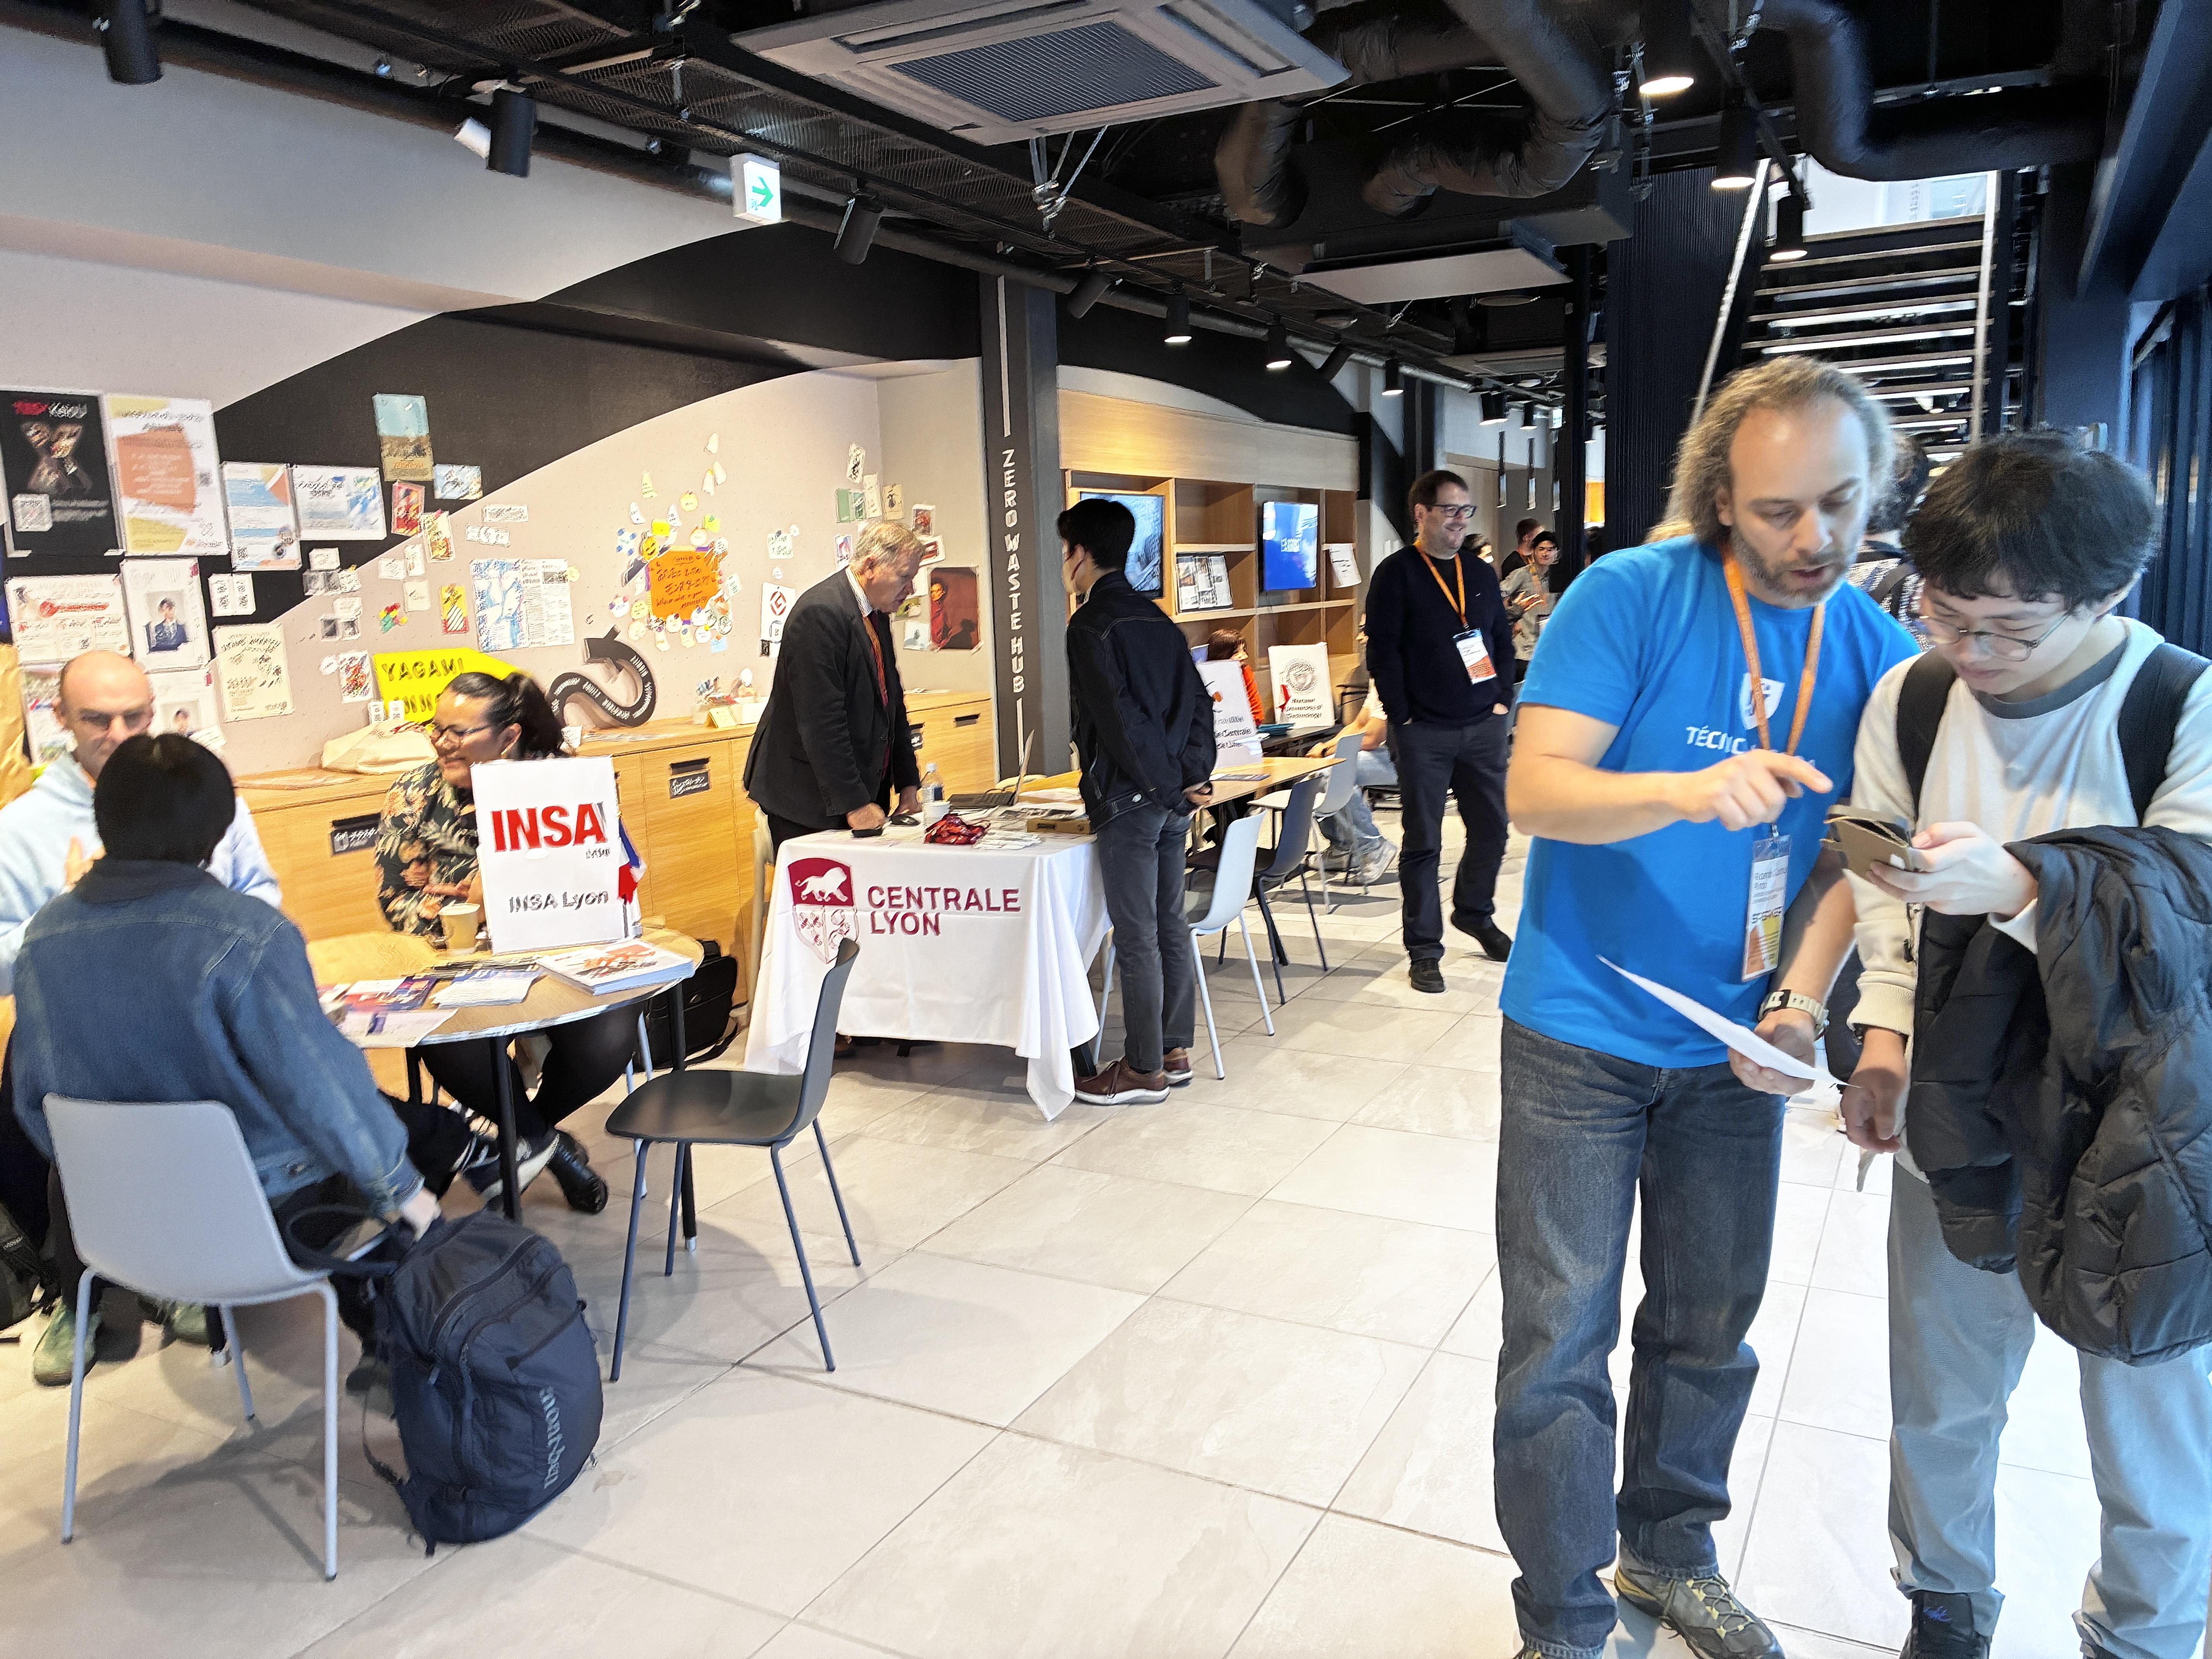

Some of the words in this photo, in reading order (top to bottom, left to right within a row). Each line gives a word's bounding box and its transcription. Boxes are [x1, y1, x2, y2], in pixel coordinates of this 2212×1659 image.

[1002, 449, 1018, 527] ZERO
[1005, 533, 1023, 630] WASTE
[381, 657, 464, 682] YAGAMI
[1011, 636, 1025, 693] HUB
[491, 802, 608, 852] INSA
[509, 893, 558, 913] INSA
[562, 891, 609, 910] Lyon
[867, 885, 1021, 912] CENTRALE
[870, 911, 941, 936] LYON
